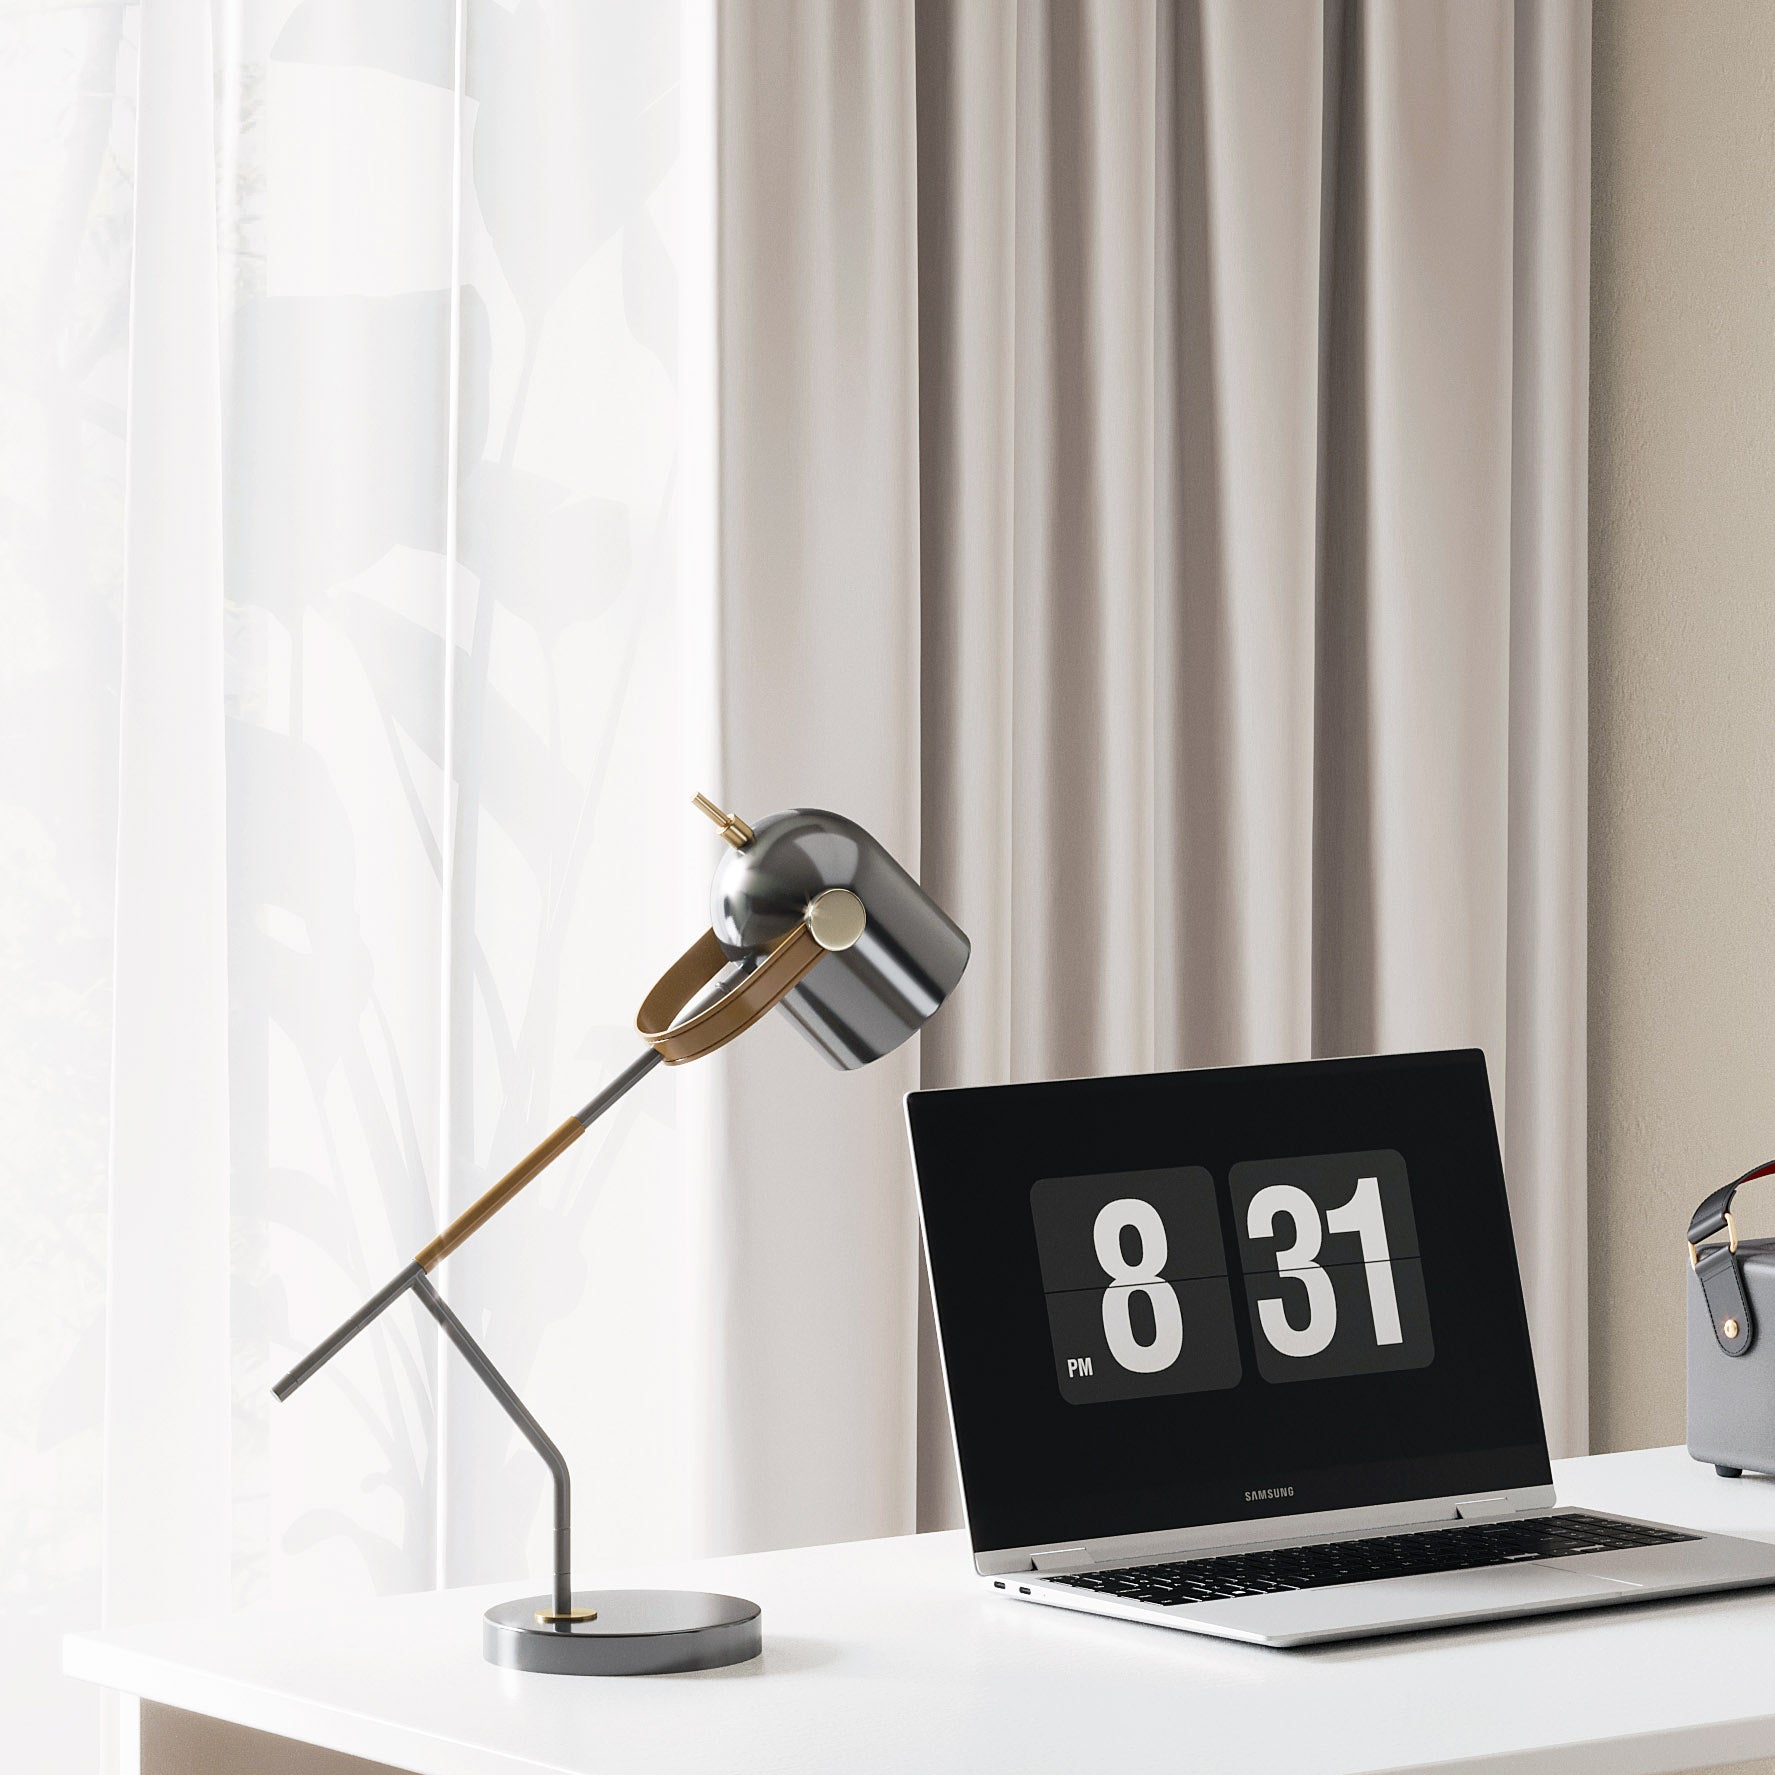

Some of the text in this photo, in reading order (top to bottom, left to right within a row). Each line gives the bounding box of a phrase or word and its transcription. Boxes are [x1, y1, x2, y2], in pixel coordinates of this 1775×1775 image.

[1093, 1176, 1403, 1374] 8 31
[1067, 1357, 1094, 1378] PM
[1244, 1486, 1295, 1502] SAMSUNG
